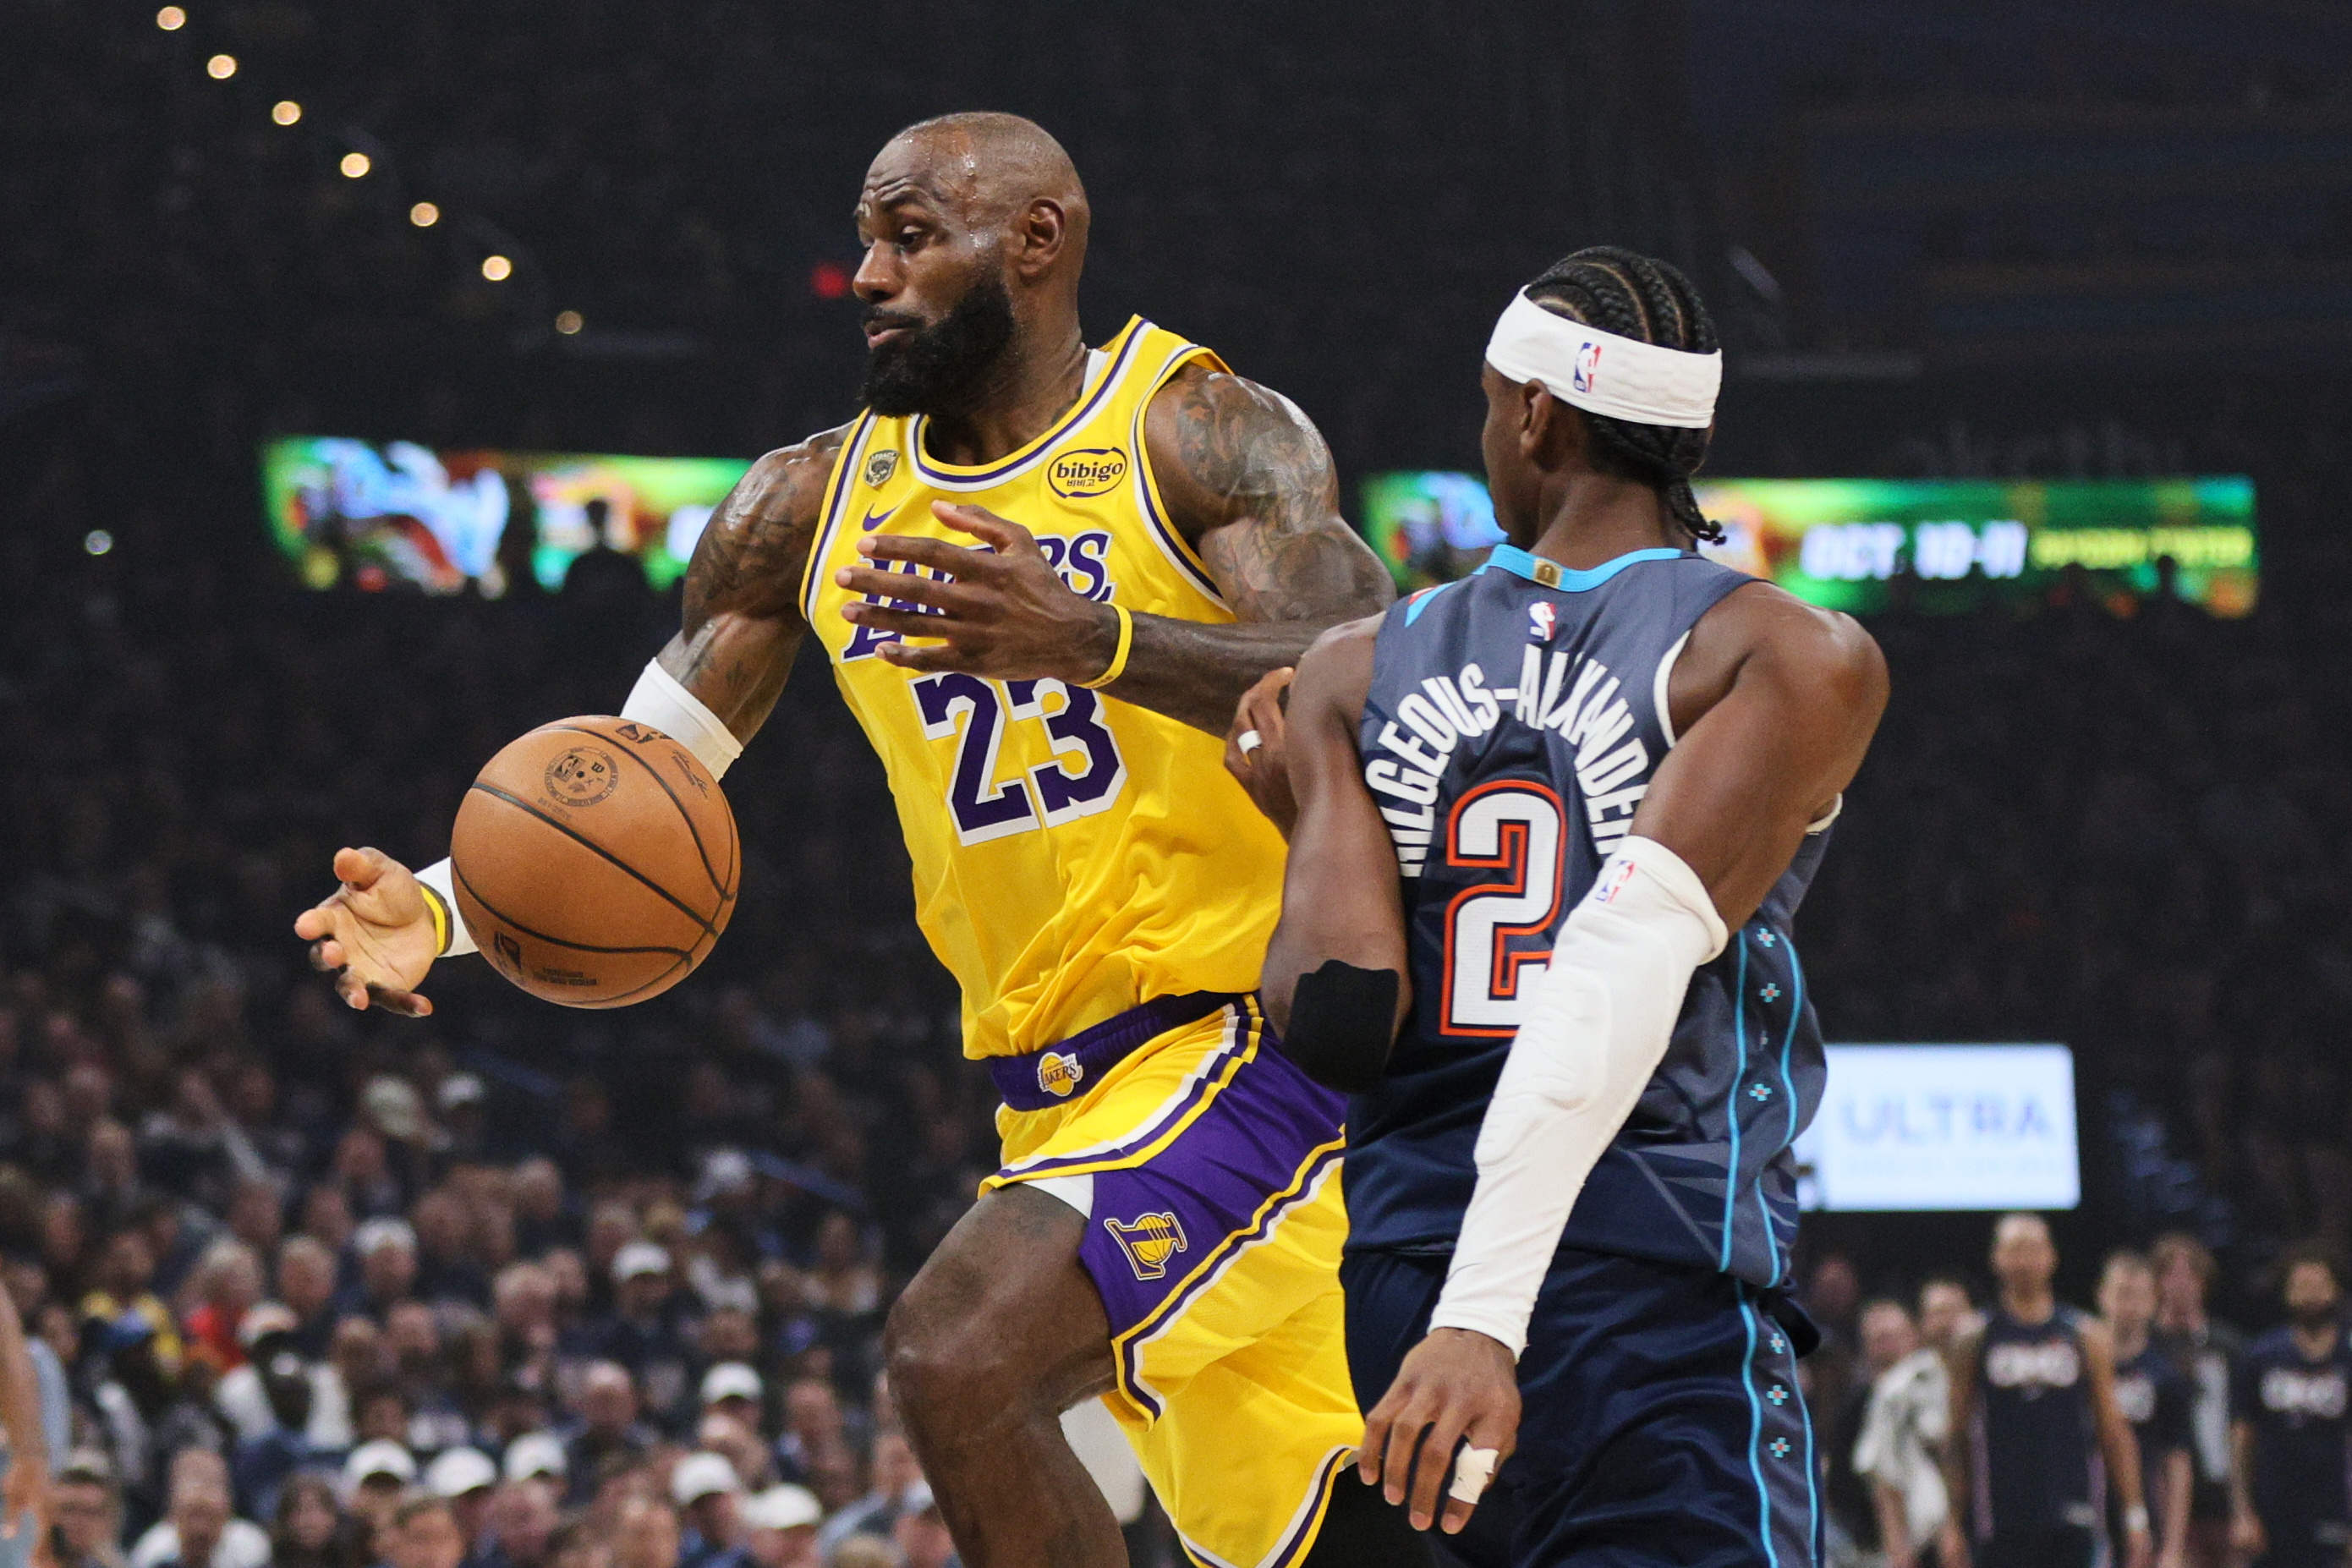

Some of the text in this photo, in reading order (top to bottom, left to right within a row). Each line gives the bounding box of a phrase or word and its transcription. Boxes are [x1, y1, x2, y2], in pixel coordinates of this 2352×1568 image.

[1056, 462, 1123, 482] bibigo
[1066, 479, 1095, 487] 비비고
[907, 673, 1128, 847] 23
[1439, 779, 1566, 1038] 2
[1039, 1063, 1083, 1090] LAKERS
[1840, 1093, 2053, 1145] ULTRA
